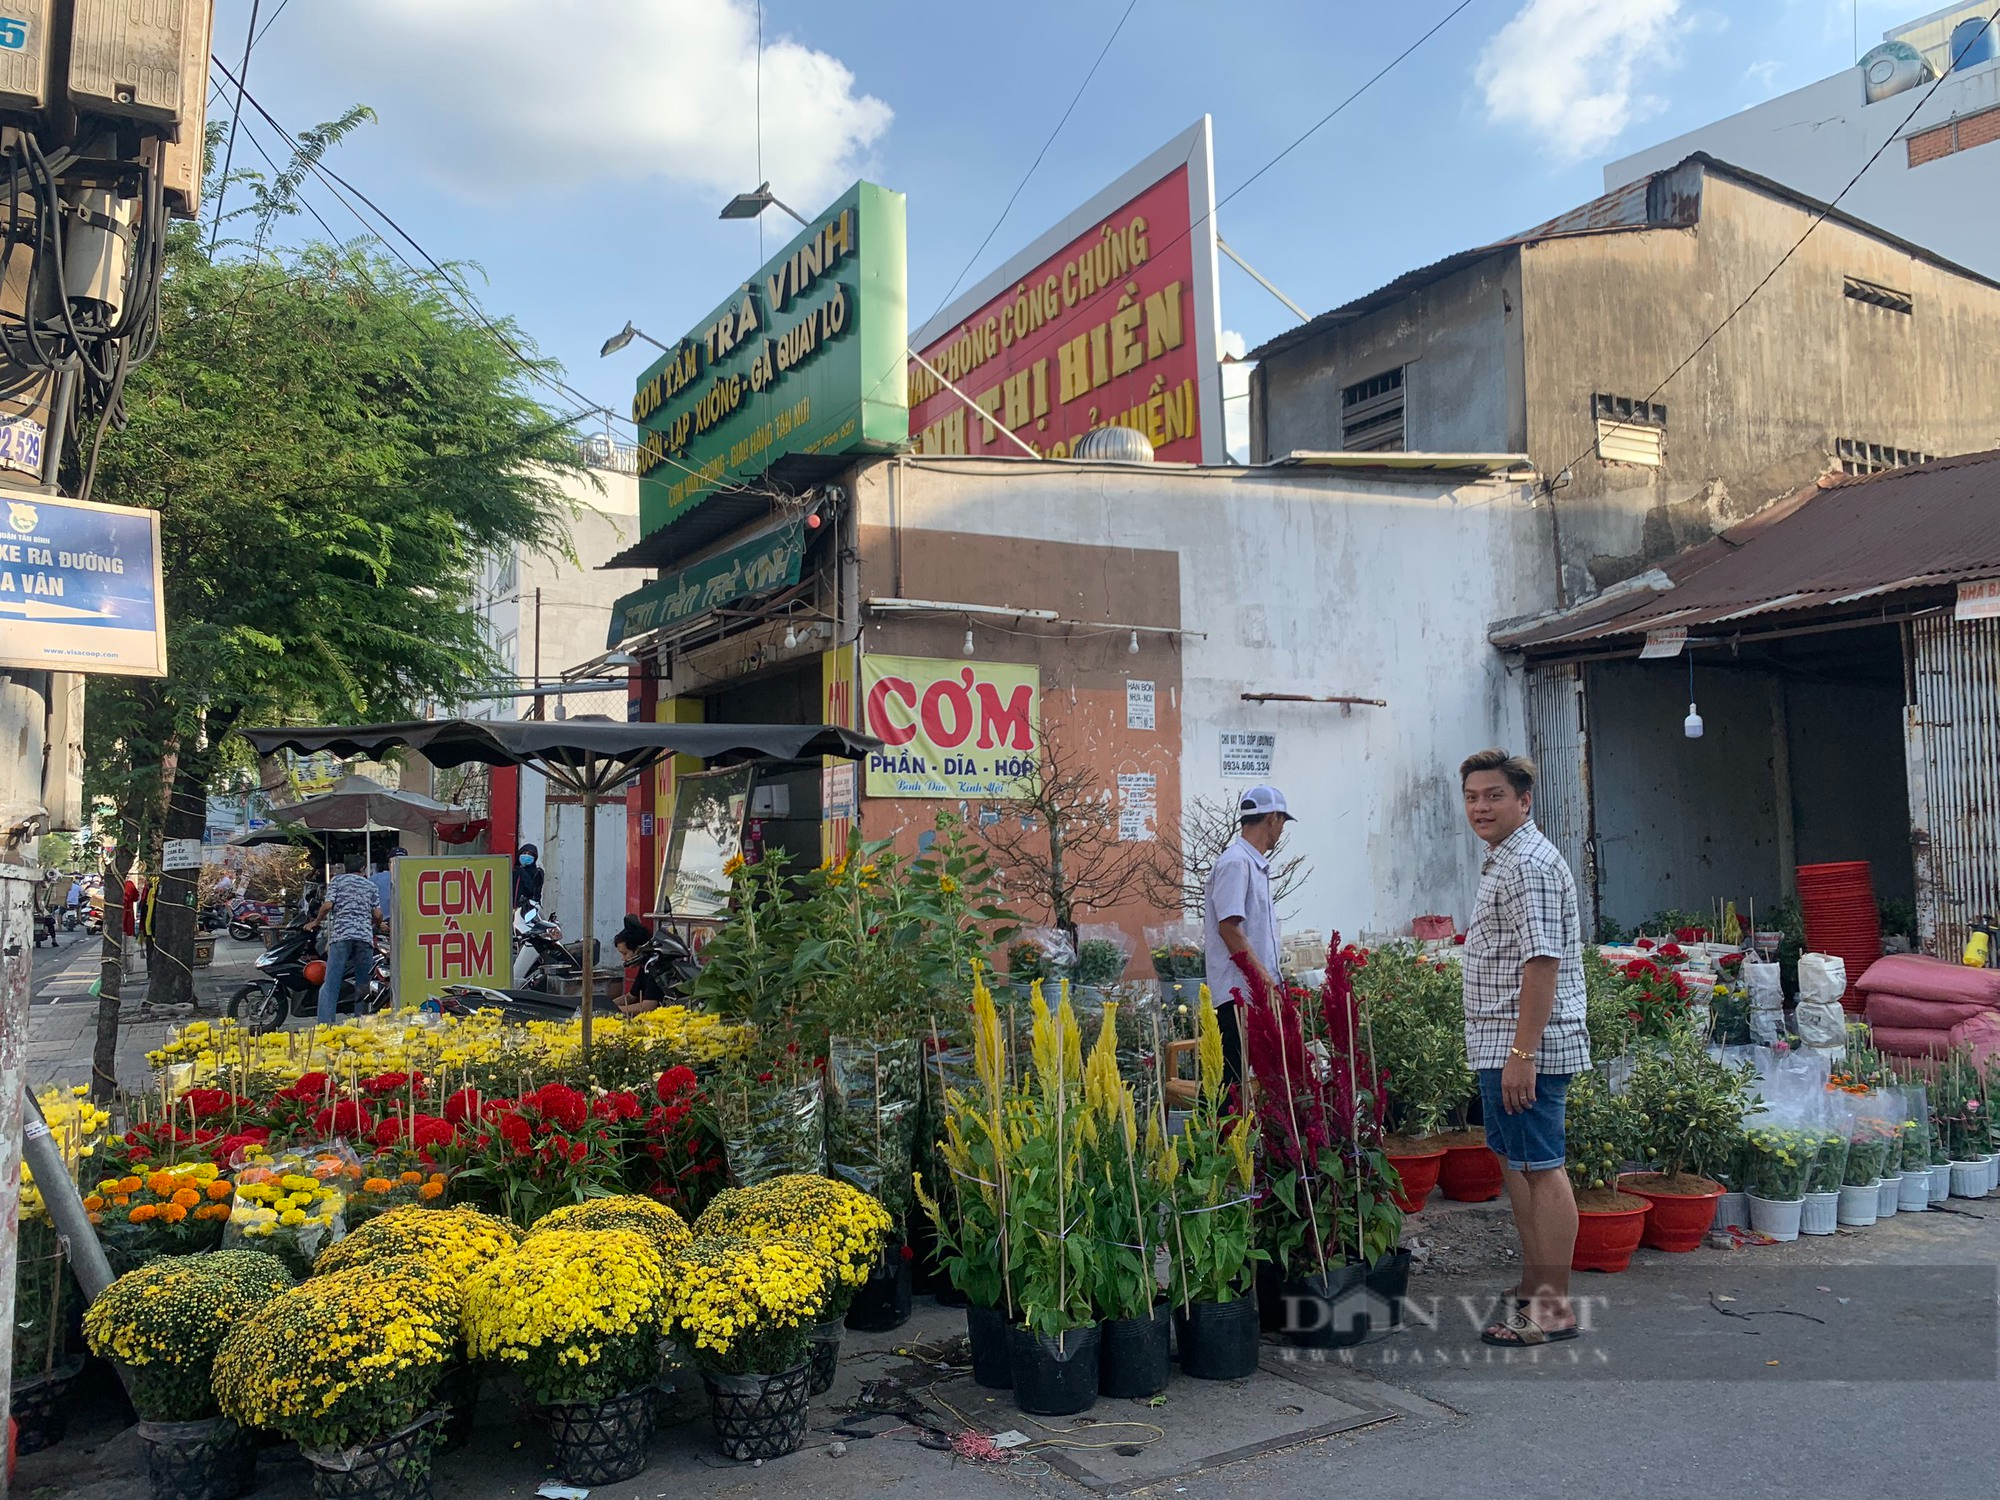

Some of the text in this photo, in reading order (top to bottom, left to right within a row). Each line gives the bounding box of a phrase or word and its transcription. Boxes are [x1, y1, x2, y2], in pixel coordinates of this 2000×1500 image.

[632, 208, 855, 424] CƠM TẤM TRÀ VINH
[940, 316, 998, 384] PHÒNG
[1000, 274, 1060, 348] CÔNG
[1062, 216, 1148, 308] CHỨNG
[670, 412, 690, 459] LẠP
[751, 339, 774, 393] GÀ
[776, 310, 822, 371] QUAY
[822, 282, 846, 340] LÒ
[976, 357, 1050, 444] THỊ
[1057, 280, 1185, 405] HIỀN
[21, 571, 63, 597] VÂN
[28, 547, 54, 566] RA
[59, 551, 123, 574] ĐƯỜNG
[43, 647, 119, 659] www.visacoop.com
[867, 667, 1035, 751] CƠM
[870, 748, 926, 775] PHẦN
[944, 753, 977, 776] DĨA
[995, 756, 1034, 779] HỘP
[1222, 760, 1270, 771] 0934.606.334
[418, 867, 494, 917] CƠM
[418, 916, 494, 981] TẤM
